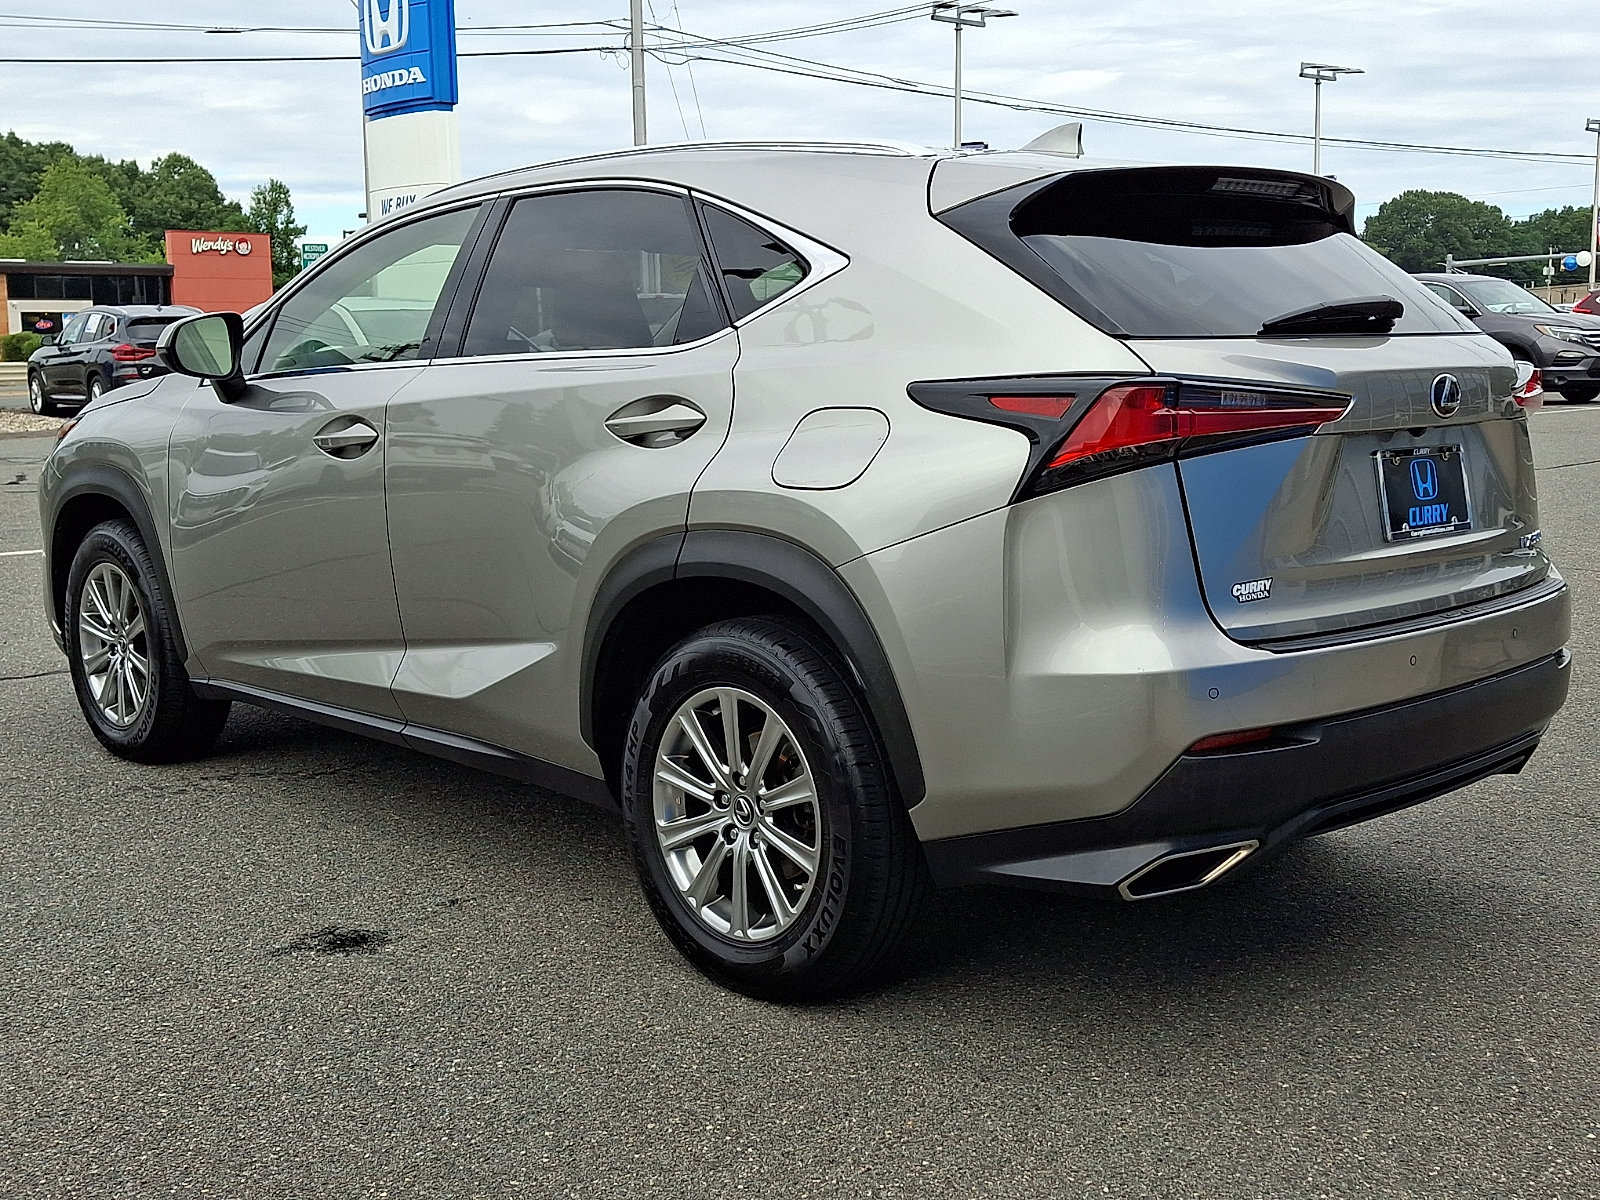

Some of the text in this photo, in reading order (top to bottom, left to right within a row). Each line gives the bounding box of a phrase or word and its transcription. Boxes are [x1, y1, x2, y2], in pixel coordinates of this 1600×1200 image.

[362, 66, 427, 95] HONDA
[191, 236, 234, 255] Wendy's
[1409, 503, 1449, 526] CURRY
[1232, 578, 1272, 597] CURRY
[1238, 590, 1270, 602] HONDA
[802, 832, 847, 960] EVOLUXX
